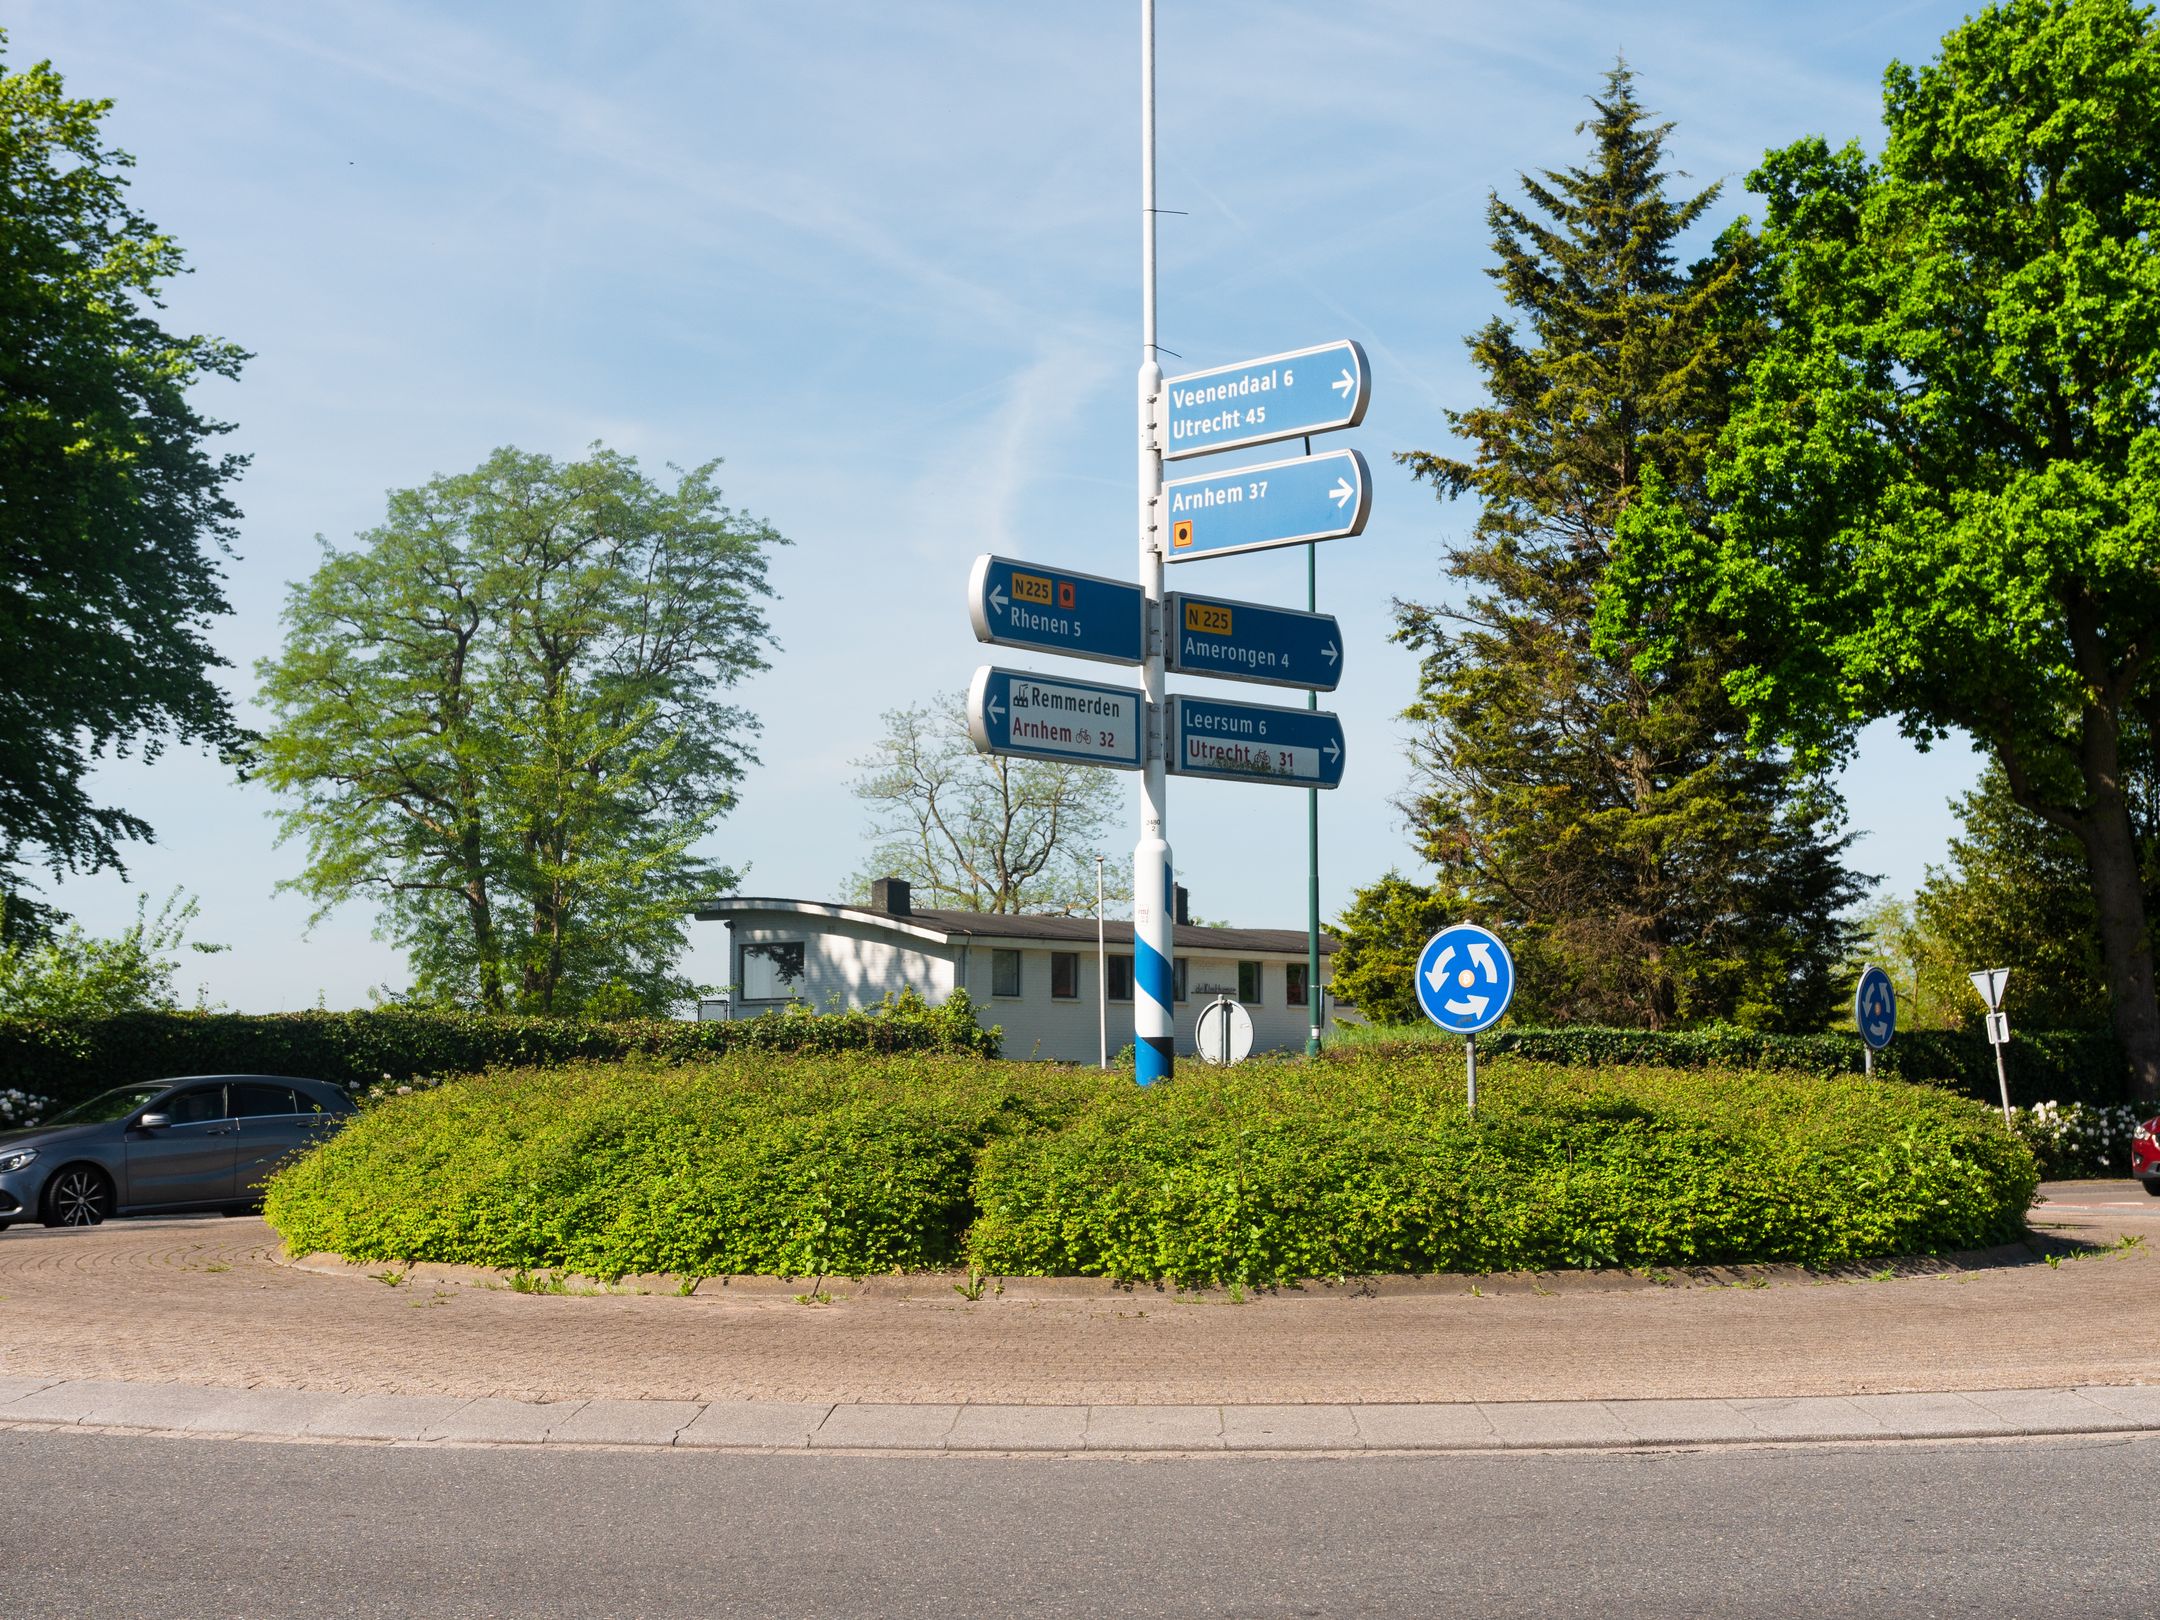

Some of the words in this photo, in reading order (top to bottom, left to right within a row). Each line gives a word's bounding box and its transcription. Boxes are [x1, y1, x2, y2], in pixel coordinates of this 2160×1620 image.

[1173, 370, 1277, 409] Veenendaal
[1283, 370, 1294, 387] 6
[1173, 411, 1240, 440] Utrecht
[1245, 406, 1266, 425] 45
[1172, 486, 1243, 513] Arnhem
[1249, 481, 1268, 500] 37
[1010, 606, 1069, 635] Rhenen
[1073, 621, 1082, 638] 5
[1185, 636, 1276, 668] Amerongen
[1281, 653, 1290, 669] 4
[1031, 687, 1120, 718] Remmerden
[1012, 717, 1072, 743] Arnhem
[1099, 731, 1115, 748] 32
[1186, 708, 1253, 735] Leersum
[1258, 720, 1268, 736] 6
[1189, 739, 1251, 764] Utrecht
[1279, 752, 1294, 768] 31
